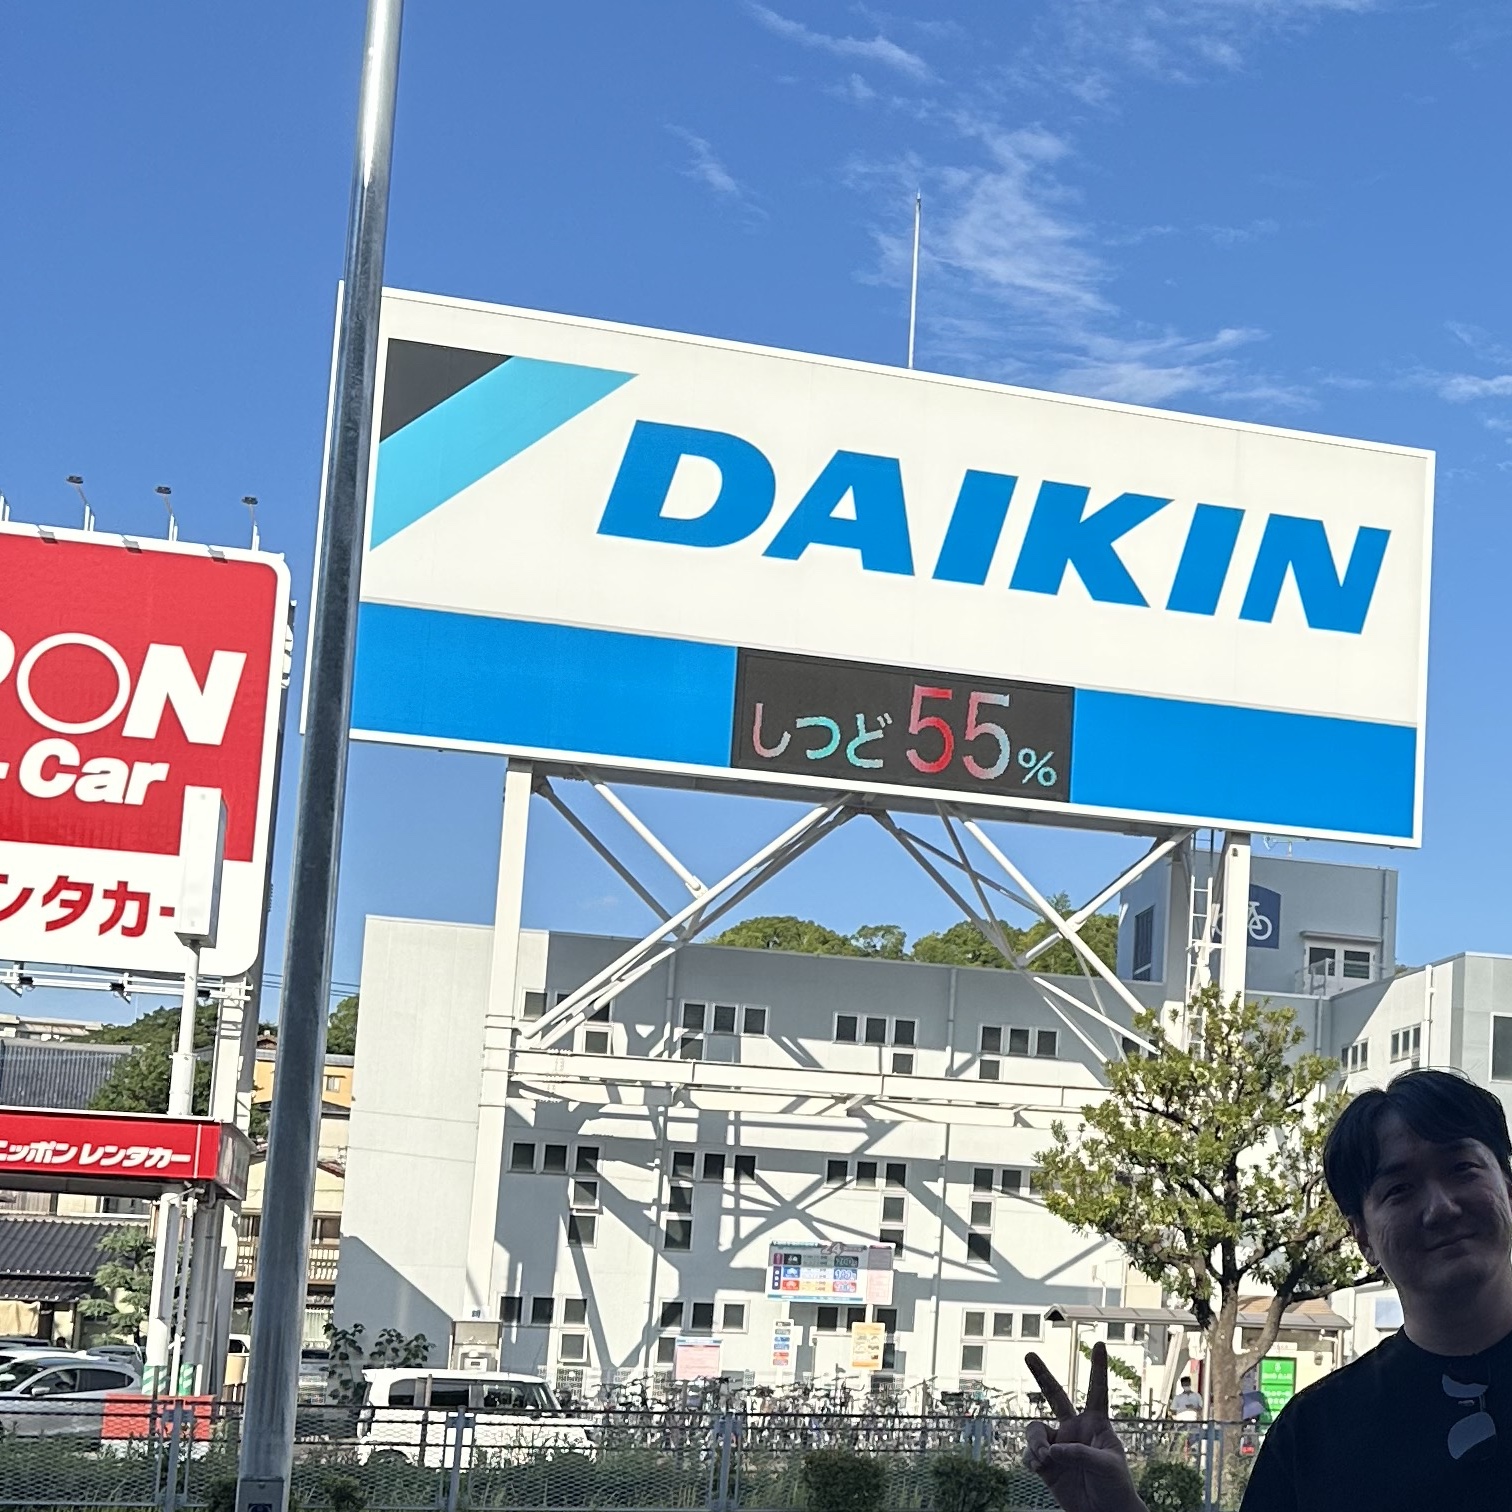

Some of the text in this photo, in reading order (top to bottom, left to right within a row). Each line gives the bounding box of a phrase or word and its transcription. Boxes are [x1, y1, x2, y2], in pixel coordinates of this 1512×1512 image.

[596, 419, 1392, 635] DAIKIN
[0, 629, 247, 746] ON
[752, 684, 1058, 787] しつど 55%
